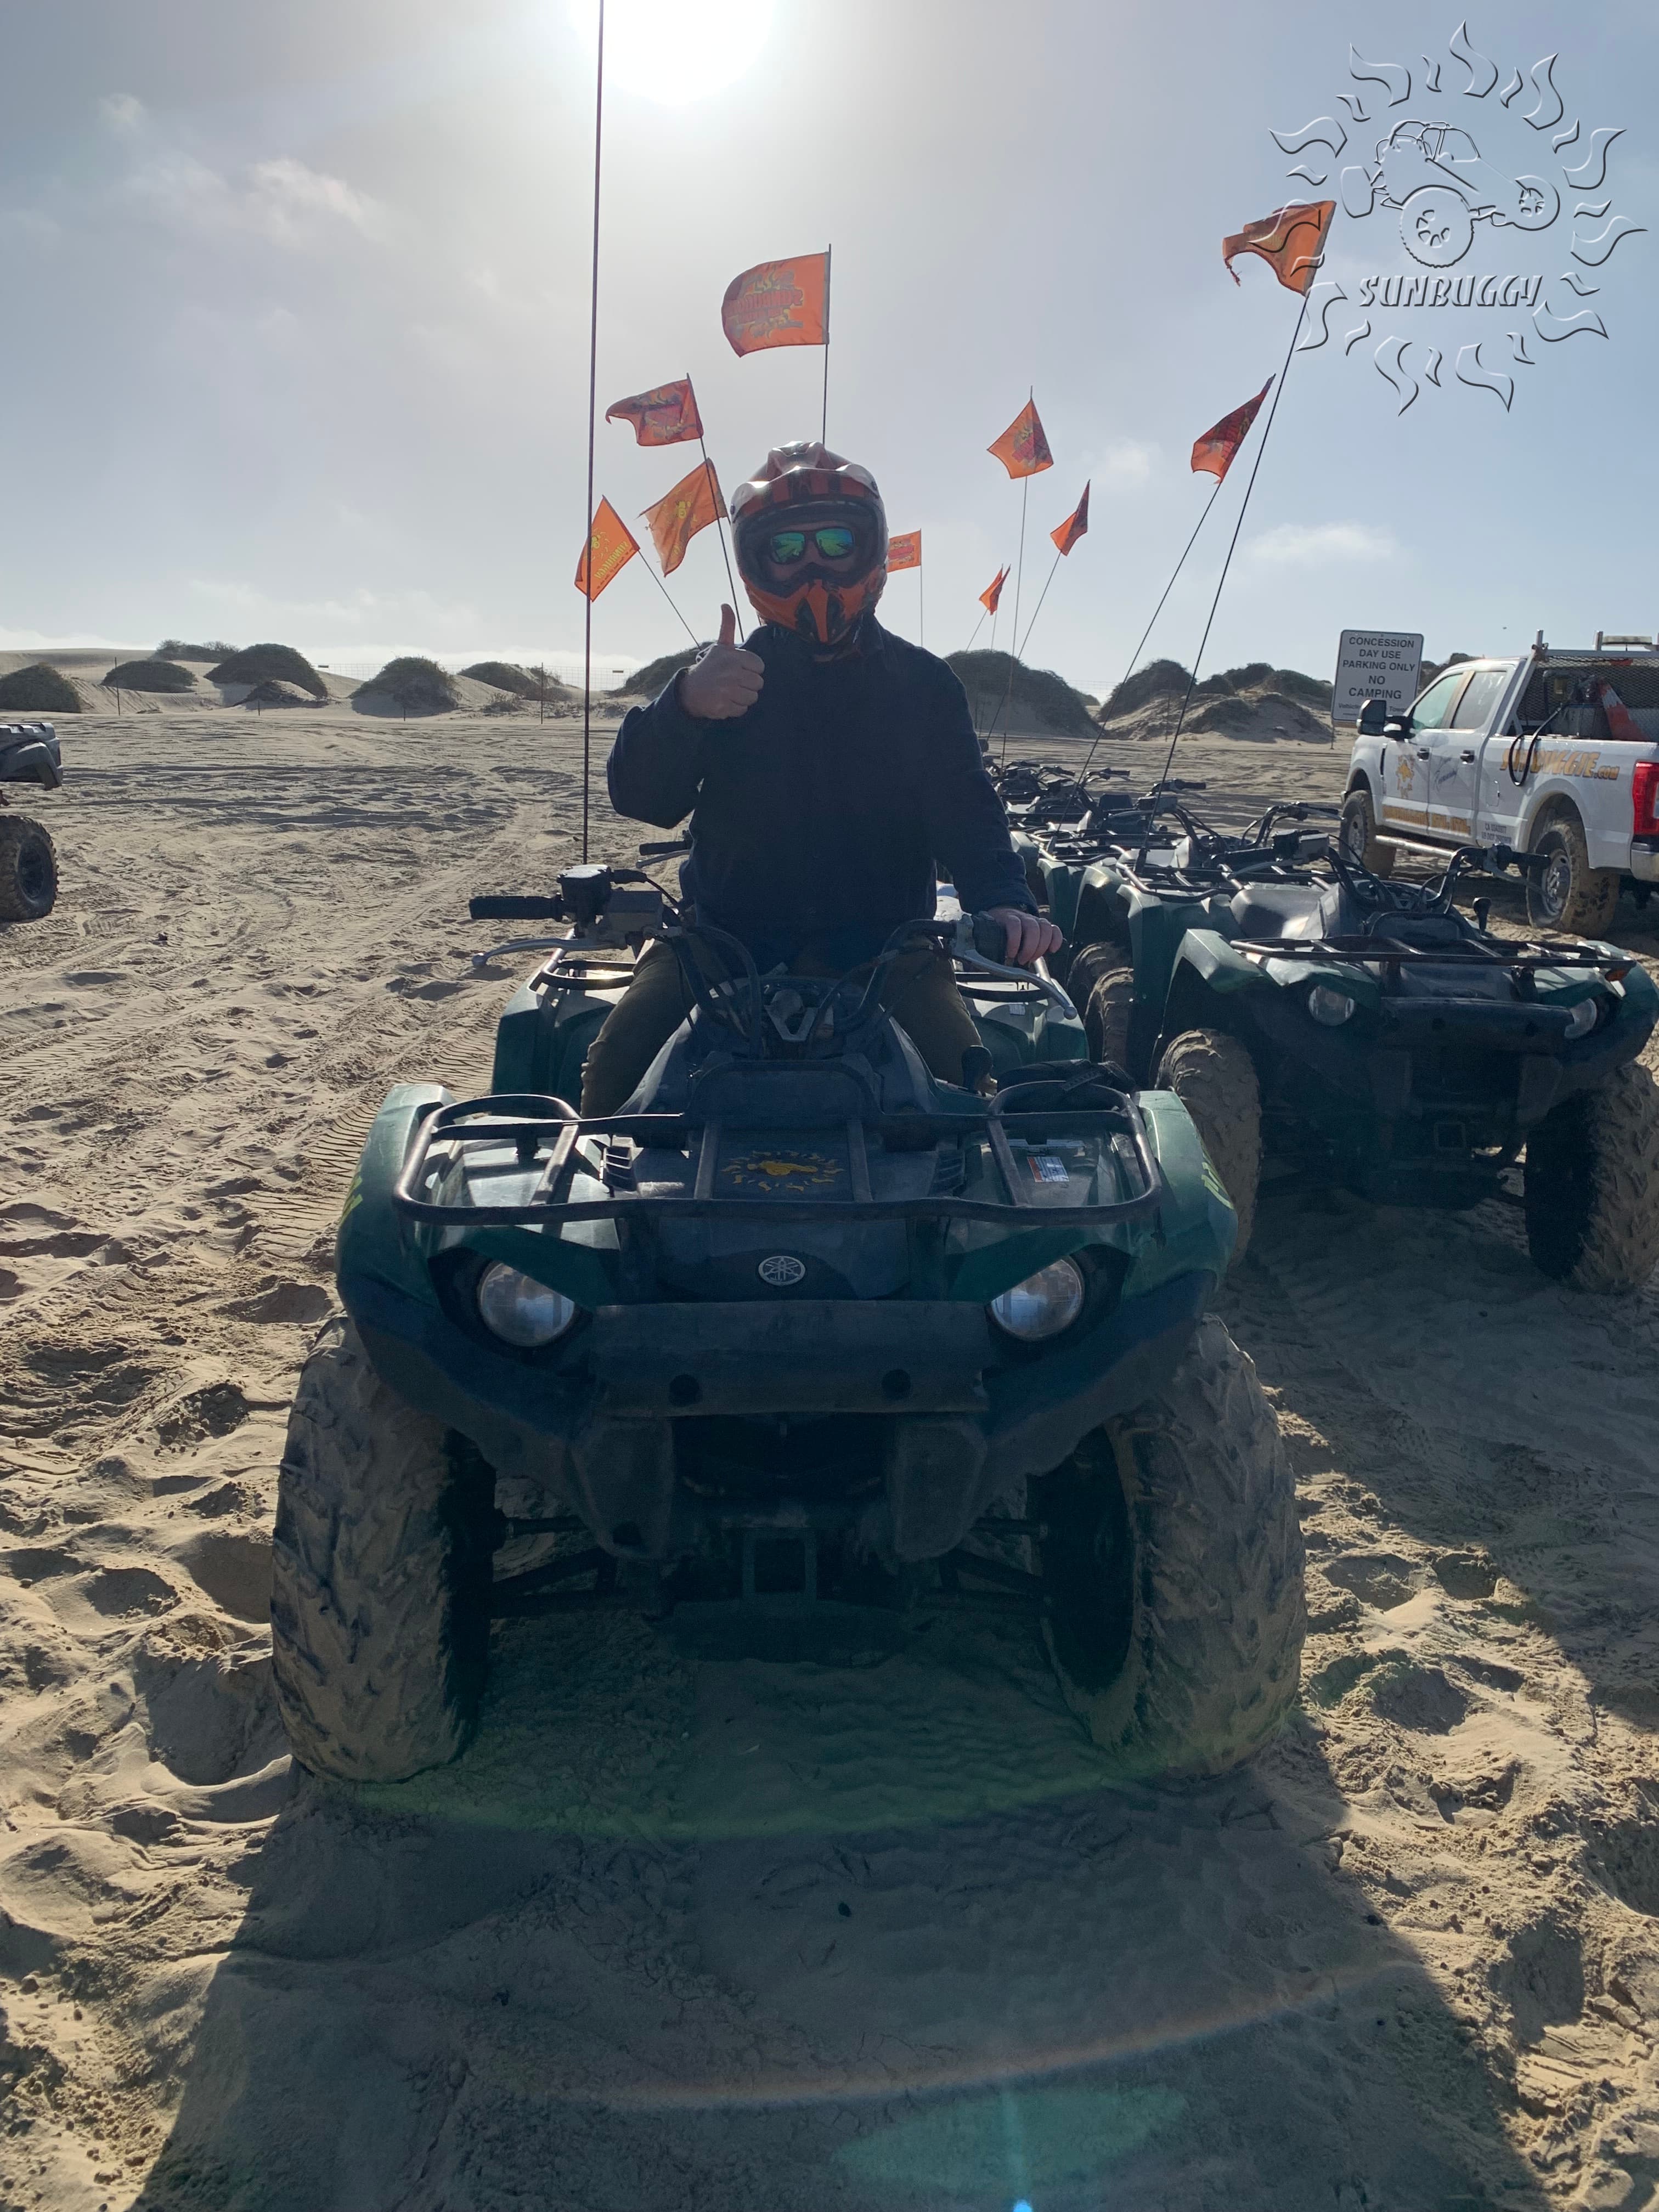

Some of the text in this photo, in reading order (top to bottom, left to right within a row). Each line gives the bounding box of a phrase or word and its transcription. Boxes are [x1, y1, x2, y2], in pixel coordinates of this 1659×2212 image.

[1349, 637, 1414, 648] CONCESSION
[1359, 649, 1401, 659] DAY USE
[1342, 660, 1415, 672] PARKING ONLY
[1368, 675, 1385, 685] NO
[1348, 687, 1402, 699] CAMPING
